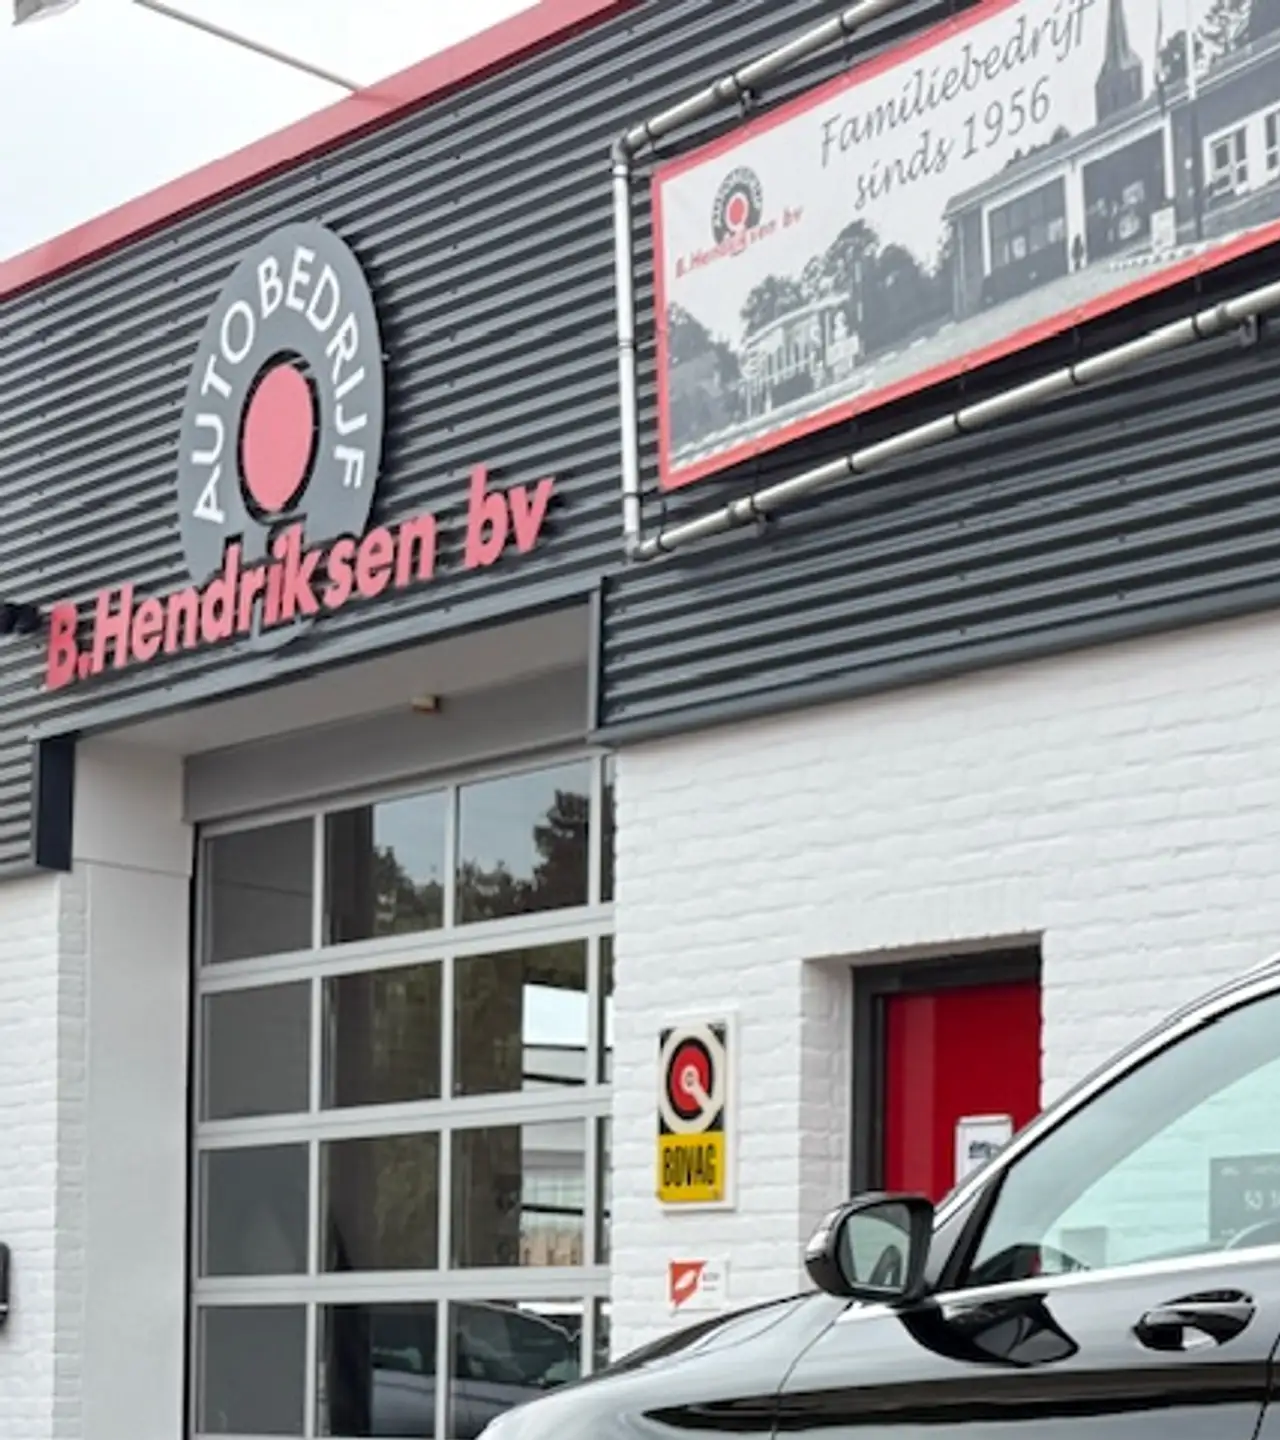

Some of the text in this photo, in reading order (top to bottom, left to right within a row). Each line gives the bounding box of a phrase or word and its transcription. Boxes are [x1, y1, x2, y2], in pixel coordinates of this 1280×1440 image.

[819, 0, 1097, 169] Familiebedrijf
[853, 127, 955, 211] sinds
[960, 74, 1051, 161] 1956
[191, 246, 368, 524] AUTOBEDRIJF
[46, 462, 555, 692] B.Hendriksen bv
[663, 1143, 717, 1188] BOVAG
